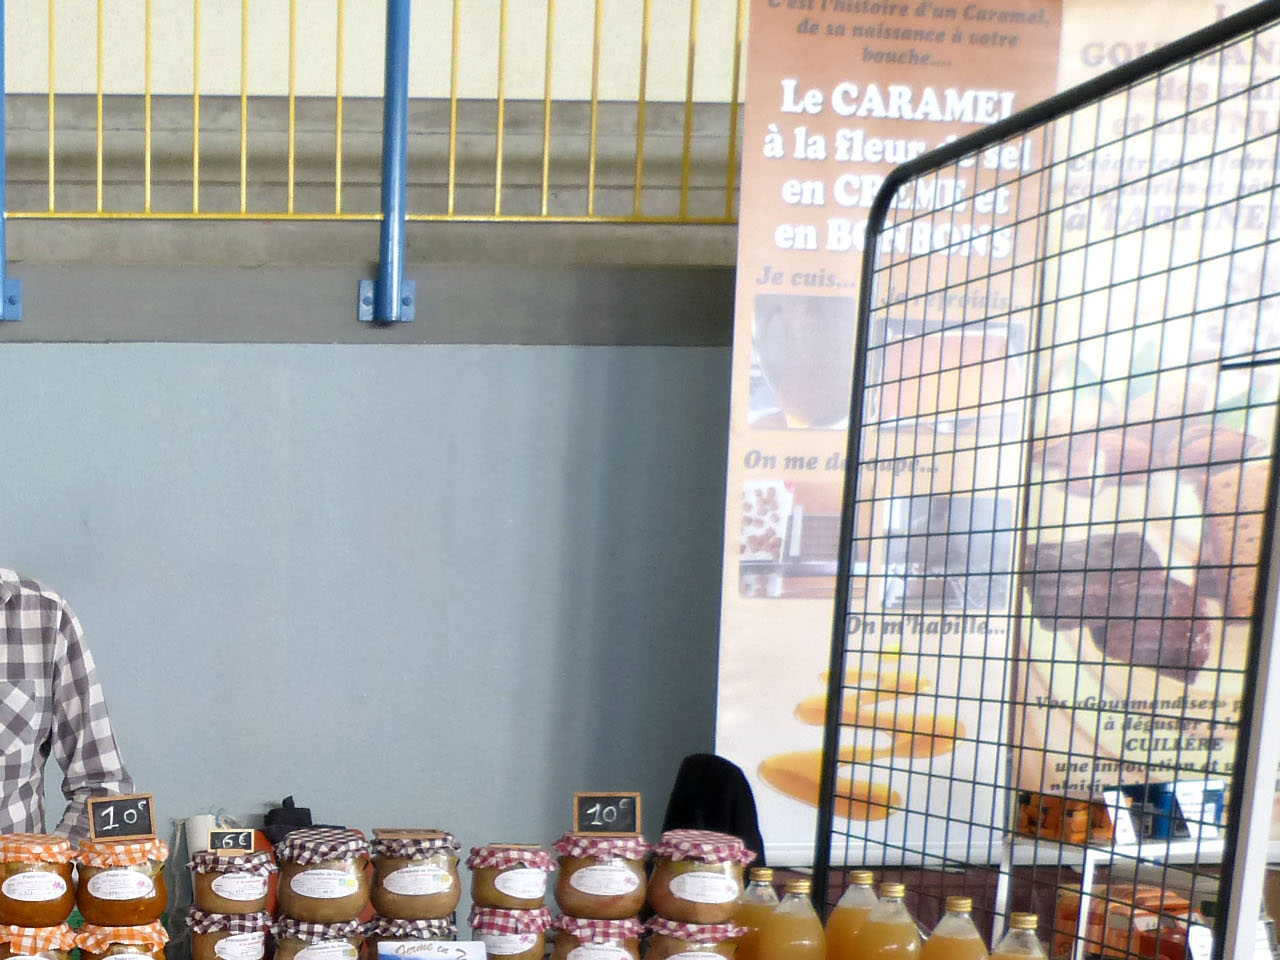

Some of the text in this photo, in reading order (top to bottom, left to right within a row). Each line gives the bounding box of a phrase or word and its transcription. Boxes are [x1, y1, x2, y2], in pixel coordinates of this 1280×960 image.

[914, 1, 958, 19] d'un
[797, 18, 1019, 47] de sa naissance à votre
[780, 77, 824, 113] Le
[763, 122, 784, 158] à
[794, 126, 828, 160] la
[983, 138, 1032, 172] sel
[781, 178, 825, 205] en
[974, 189, 1010, 214] et
[775, 223, 818, 250] en
[756, 266, 784, 287] Je
[744, 449, 777, 470] On
[784, 454, 818, 470] me
[1055, 762, 1089, 773] une
